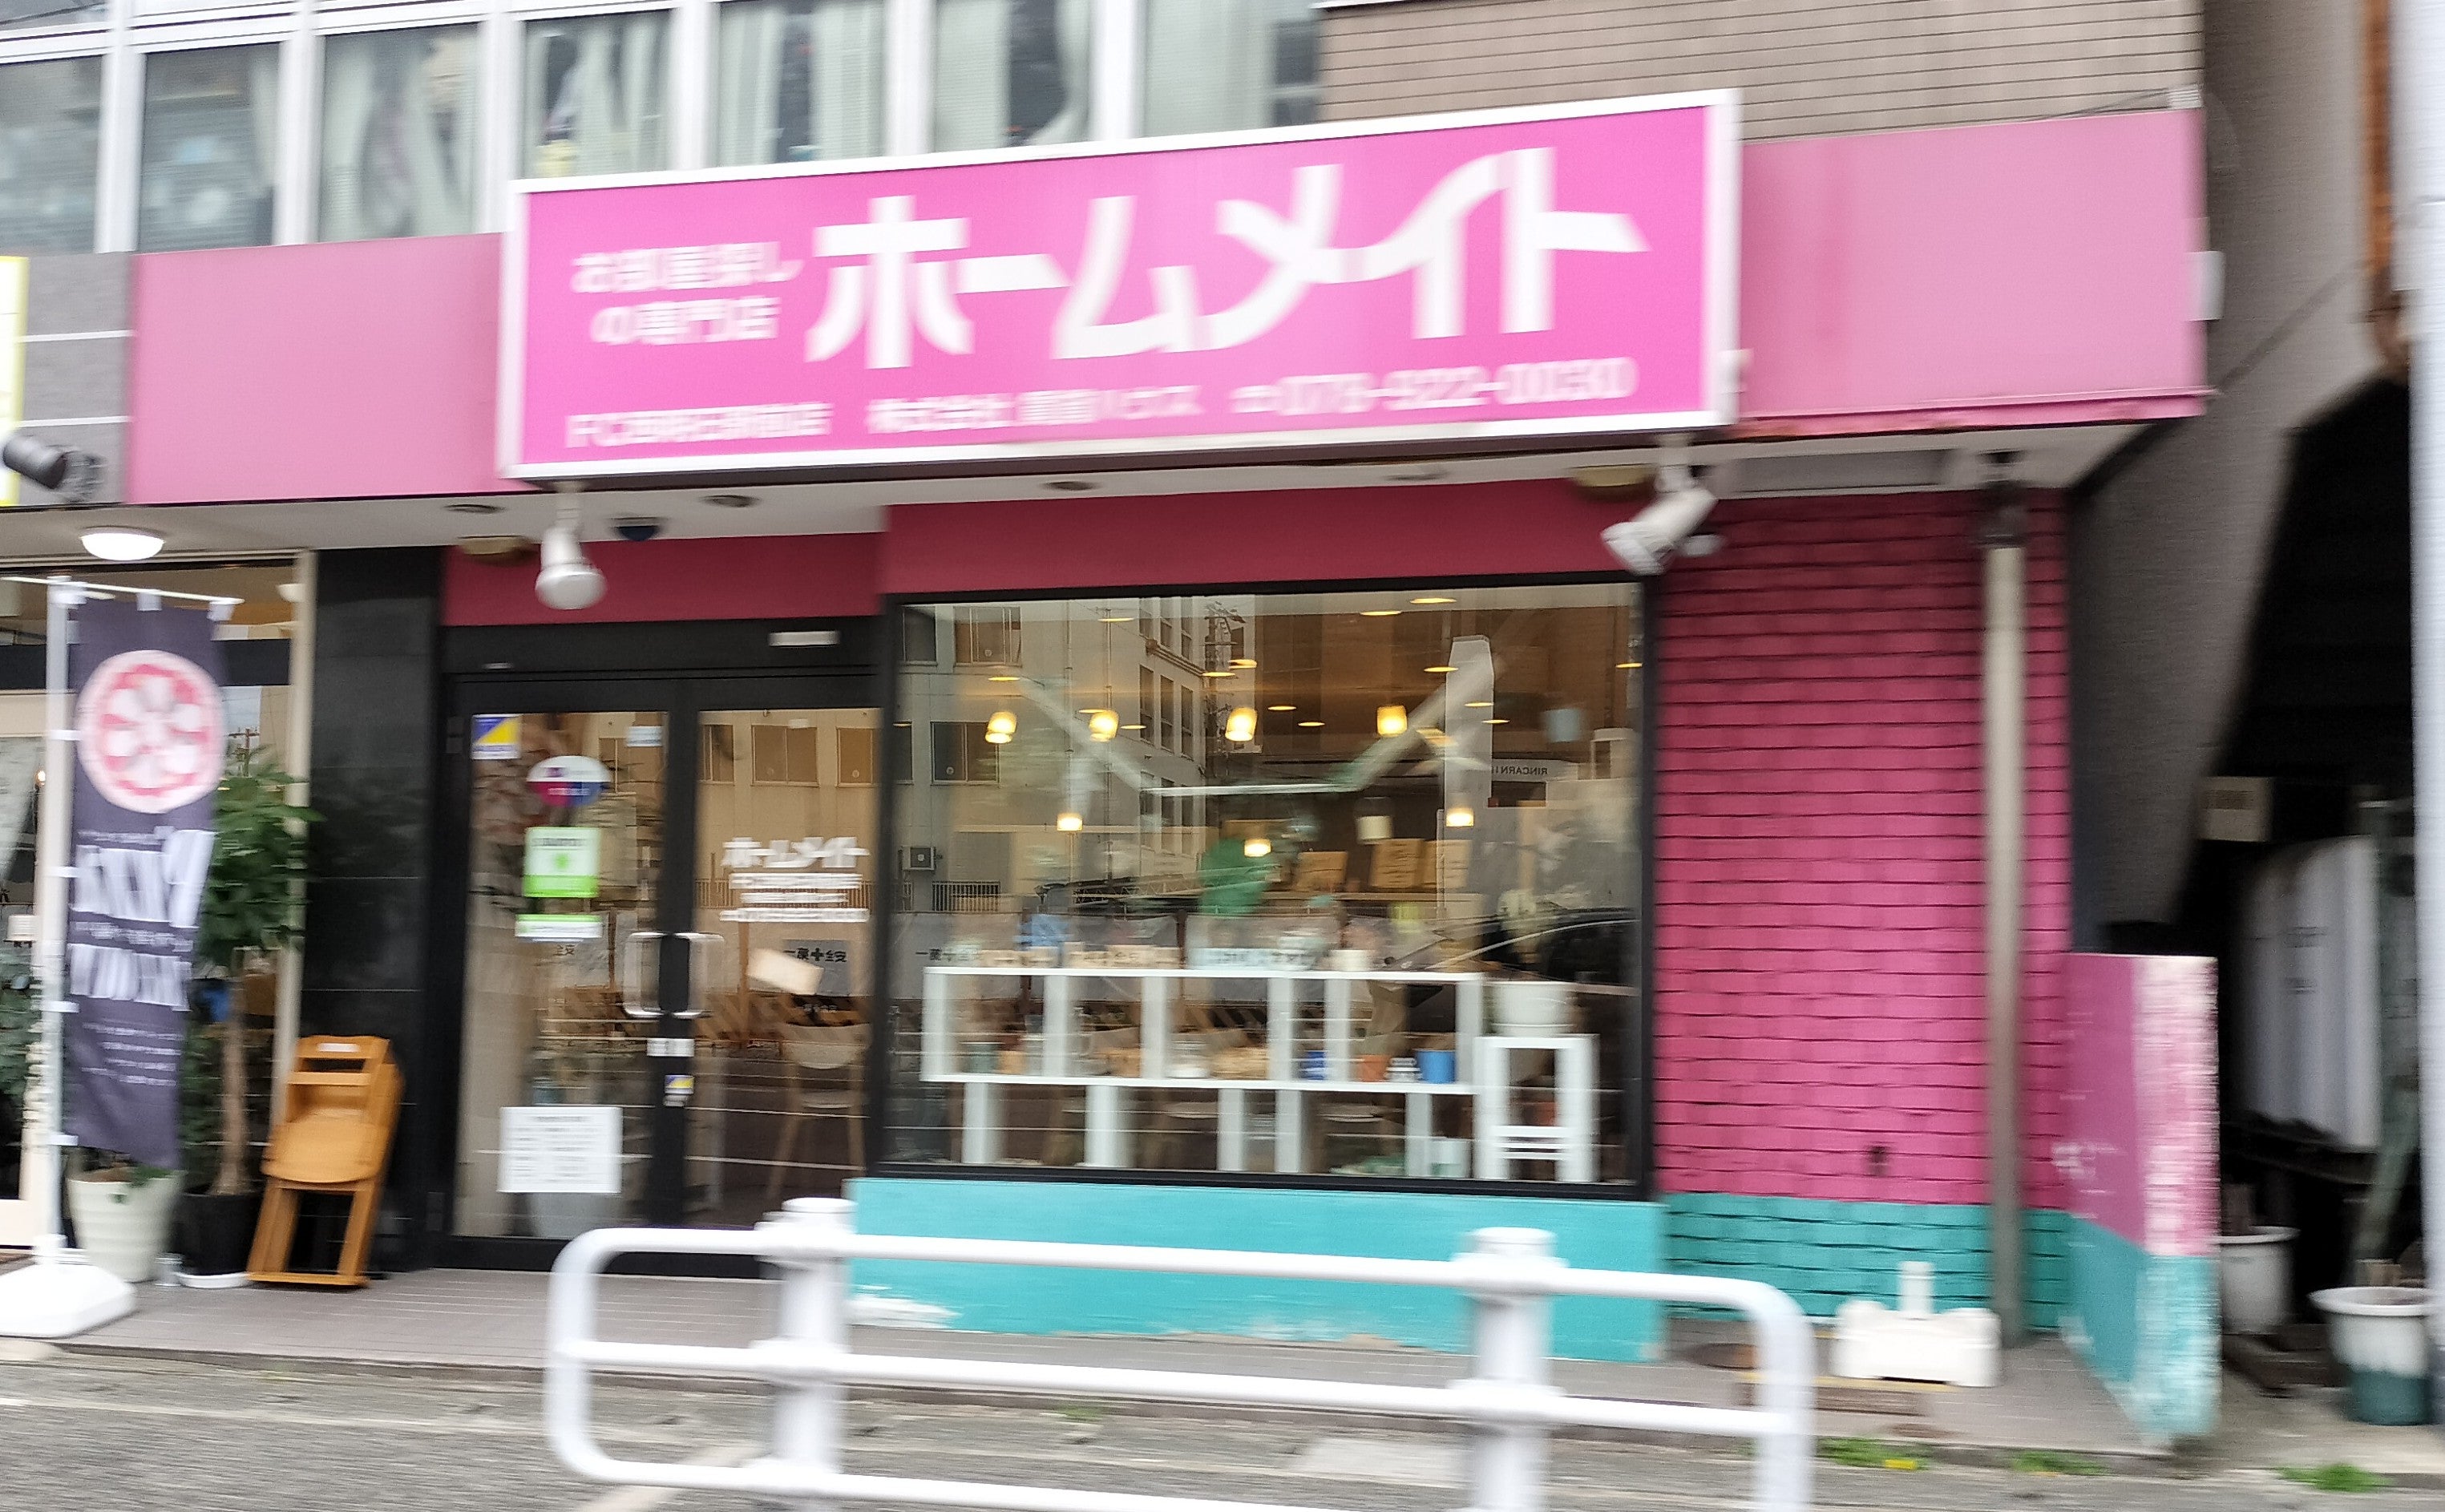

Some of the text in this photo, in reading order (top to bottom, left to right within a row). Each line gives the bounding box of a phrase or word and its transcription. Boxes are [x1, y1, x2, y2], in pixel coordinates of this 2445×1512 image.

[570, 241, 804, 293] お部屋探し
[804, 147, 1651, 370] ホームメイト
[590, 296, 782, 346] の専門店
